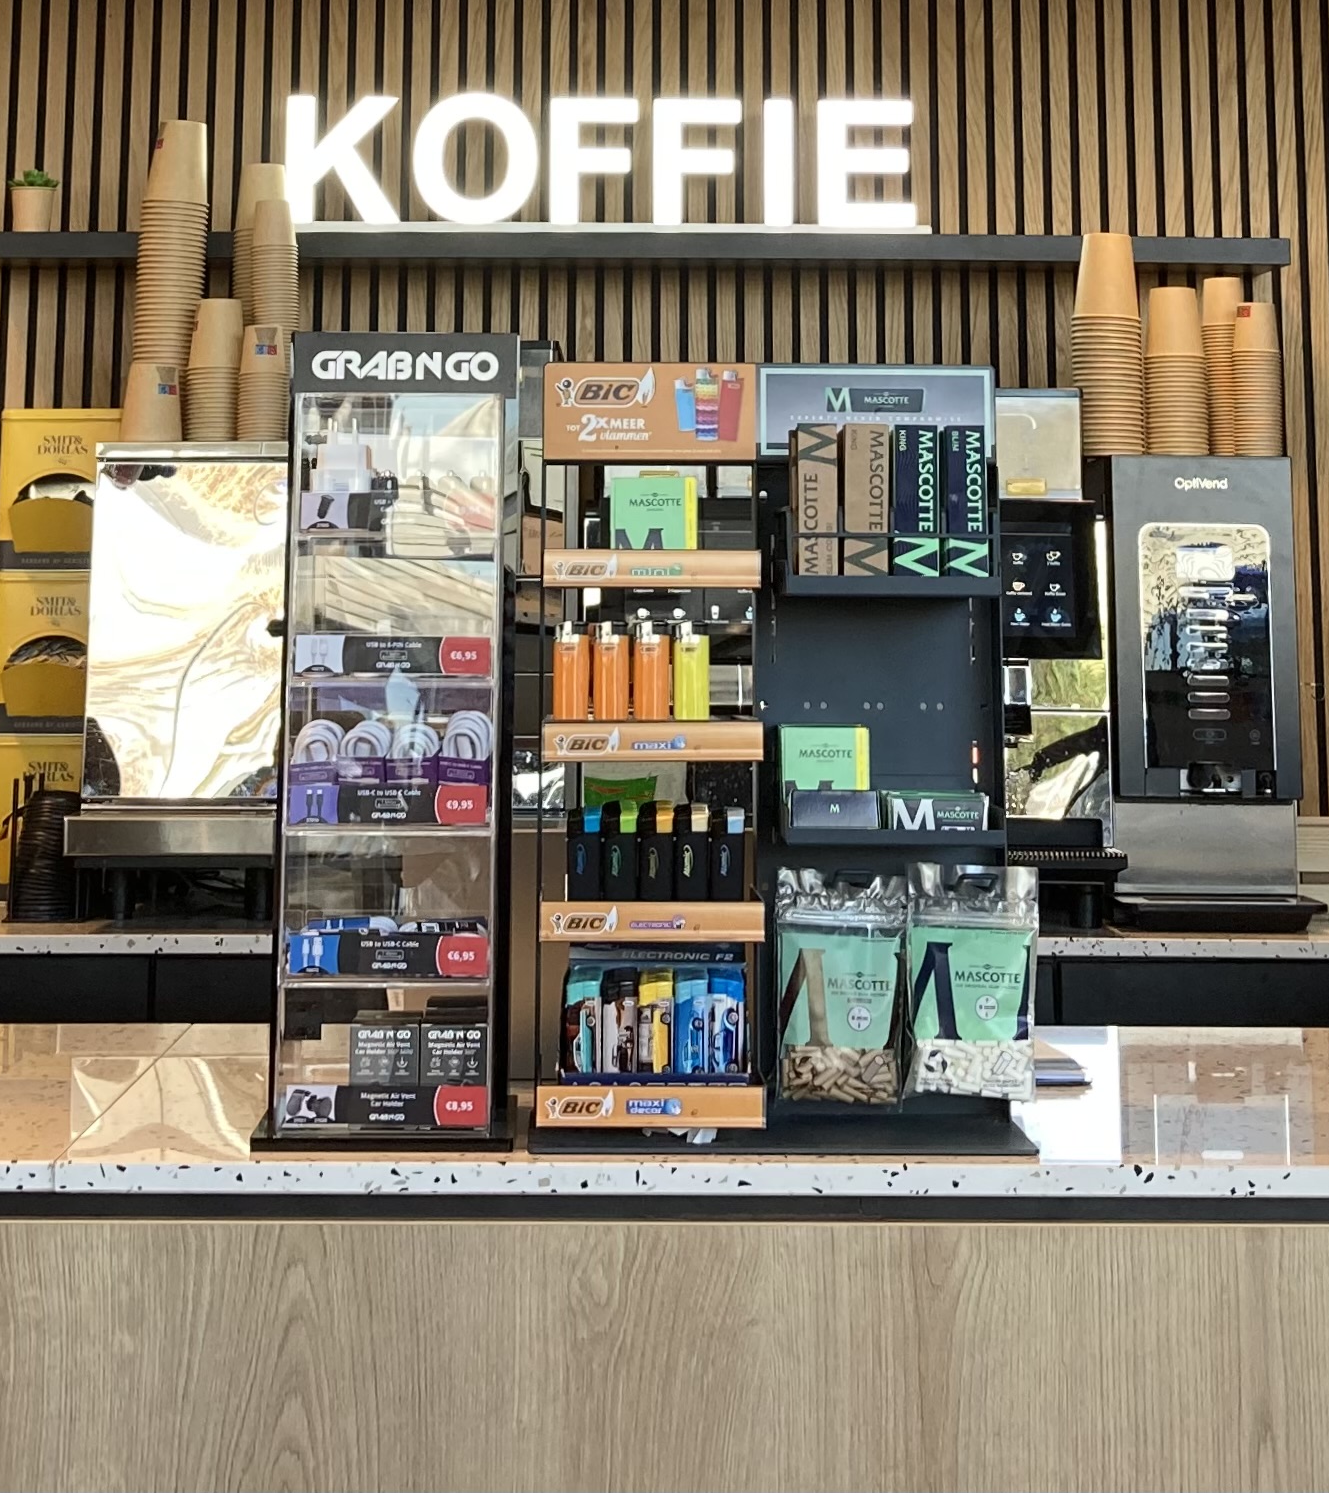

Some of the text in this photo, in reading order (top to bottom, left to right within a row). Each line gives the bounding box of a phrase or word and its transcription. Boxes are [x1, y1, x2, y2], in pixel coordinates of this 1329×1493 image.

[285, 92, 918, 228] KOFFIE
[864, 396, 909, 404] MASCOTTE
[609, 419, 645, 429] MEER
[898, 430, 907, 451] KING
[869, 430, 884, 531] MASCOTTE
[918, 430, 933, 532] MASCOTTE
[965, 430, 982, 532] MASCOTTE
[1175, 477, 1228, 490] OptiVend
[629, 498, 681, 506] MASCOTTE
[450, 651, 477, 661] €6,95
[799, 749, 853, 759] MASCOTTE
[446, 801, 473, 810] €9,95
[448, 952, 475, 961] €6,95
[622, 952, 710, 961] ELECTRONIC
[954, 971, 1020, 983] MASCOTTE
[446, 1101, 473, 1111] €8,95
